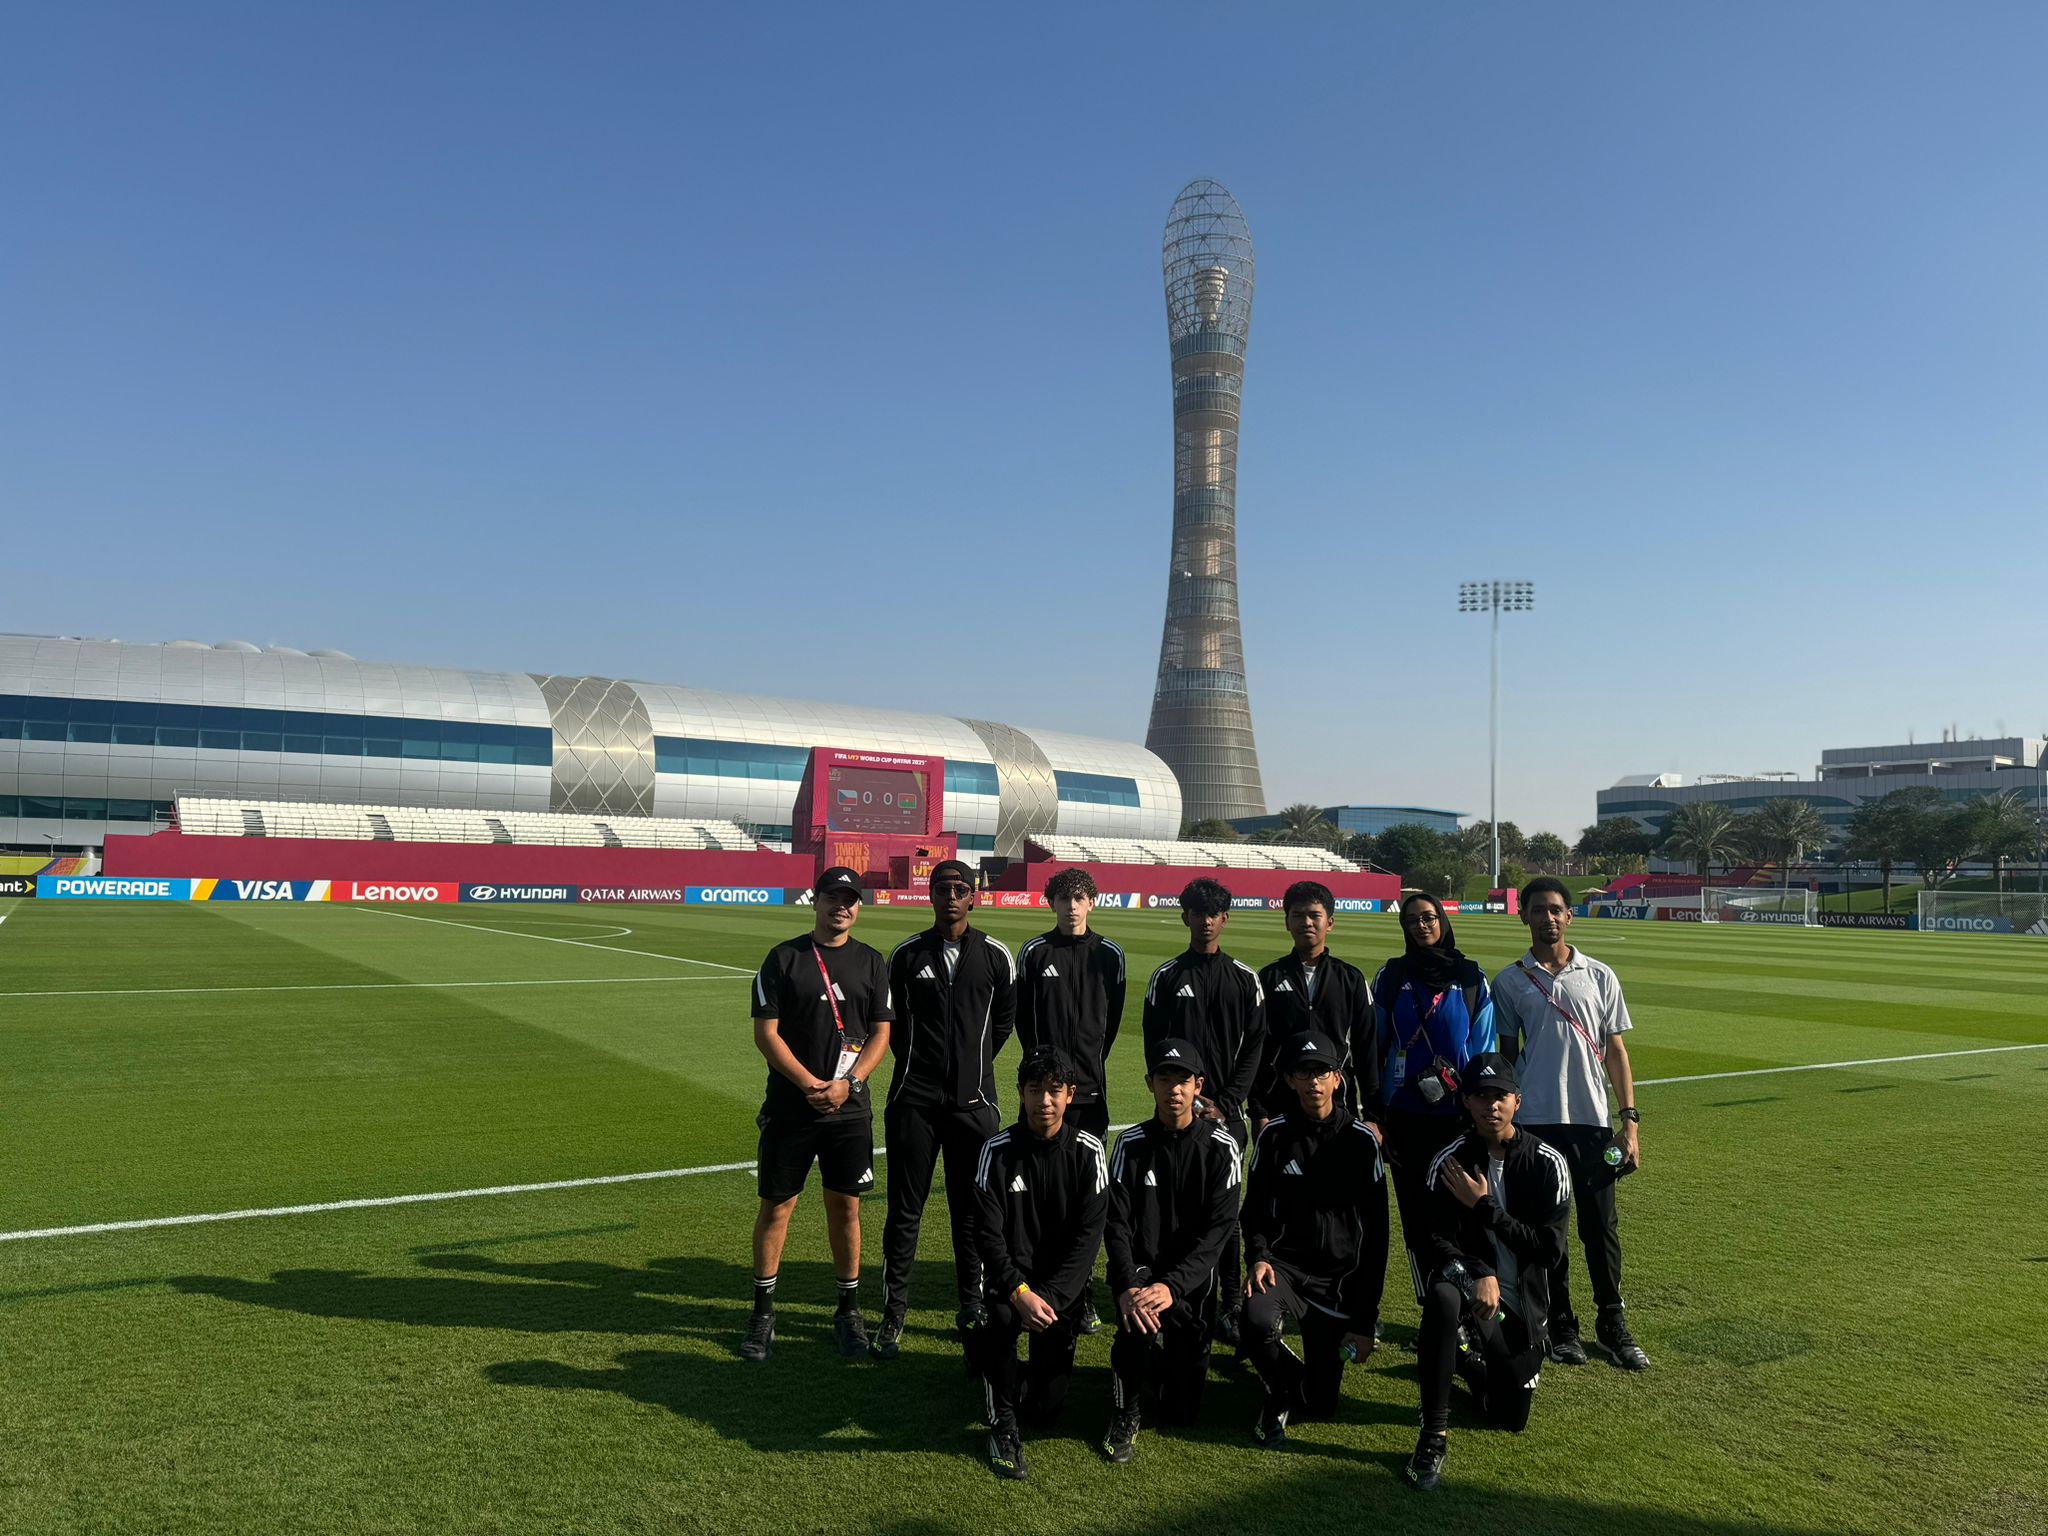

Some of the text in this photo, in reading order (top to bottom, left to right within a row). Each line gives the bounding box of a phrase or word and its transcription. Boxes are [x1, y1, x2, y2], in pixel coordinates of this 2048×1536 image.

[863, 791, 893, 805] 0 0
[56, 879, 171, 897] POWERADE
[231, 880, 294, 900] VISA
[351, 882, 439, 901] Lenovo
[500, 887, 567, 900] HYUNDAI
[580, 888, 682, 902] QATAR AIRWAYS
[700, 888, 769, 903] aramco
[1335, 899, 1373, 911] aramco
[1608, 906, 1639, 919] VISA
[1819, 914, 1907, 928] QATAR AIRWAYS
